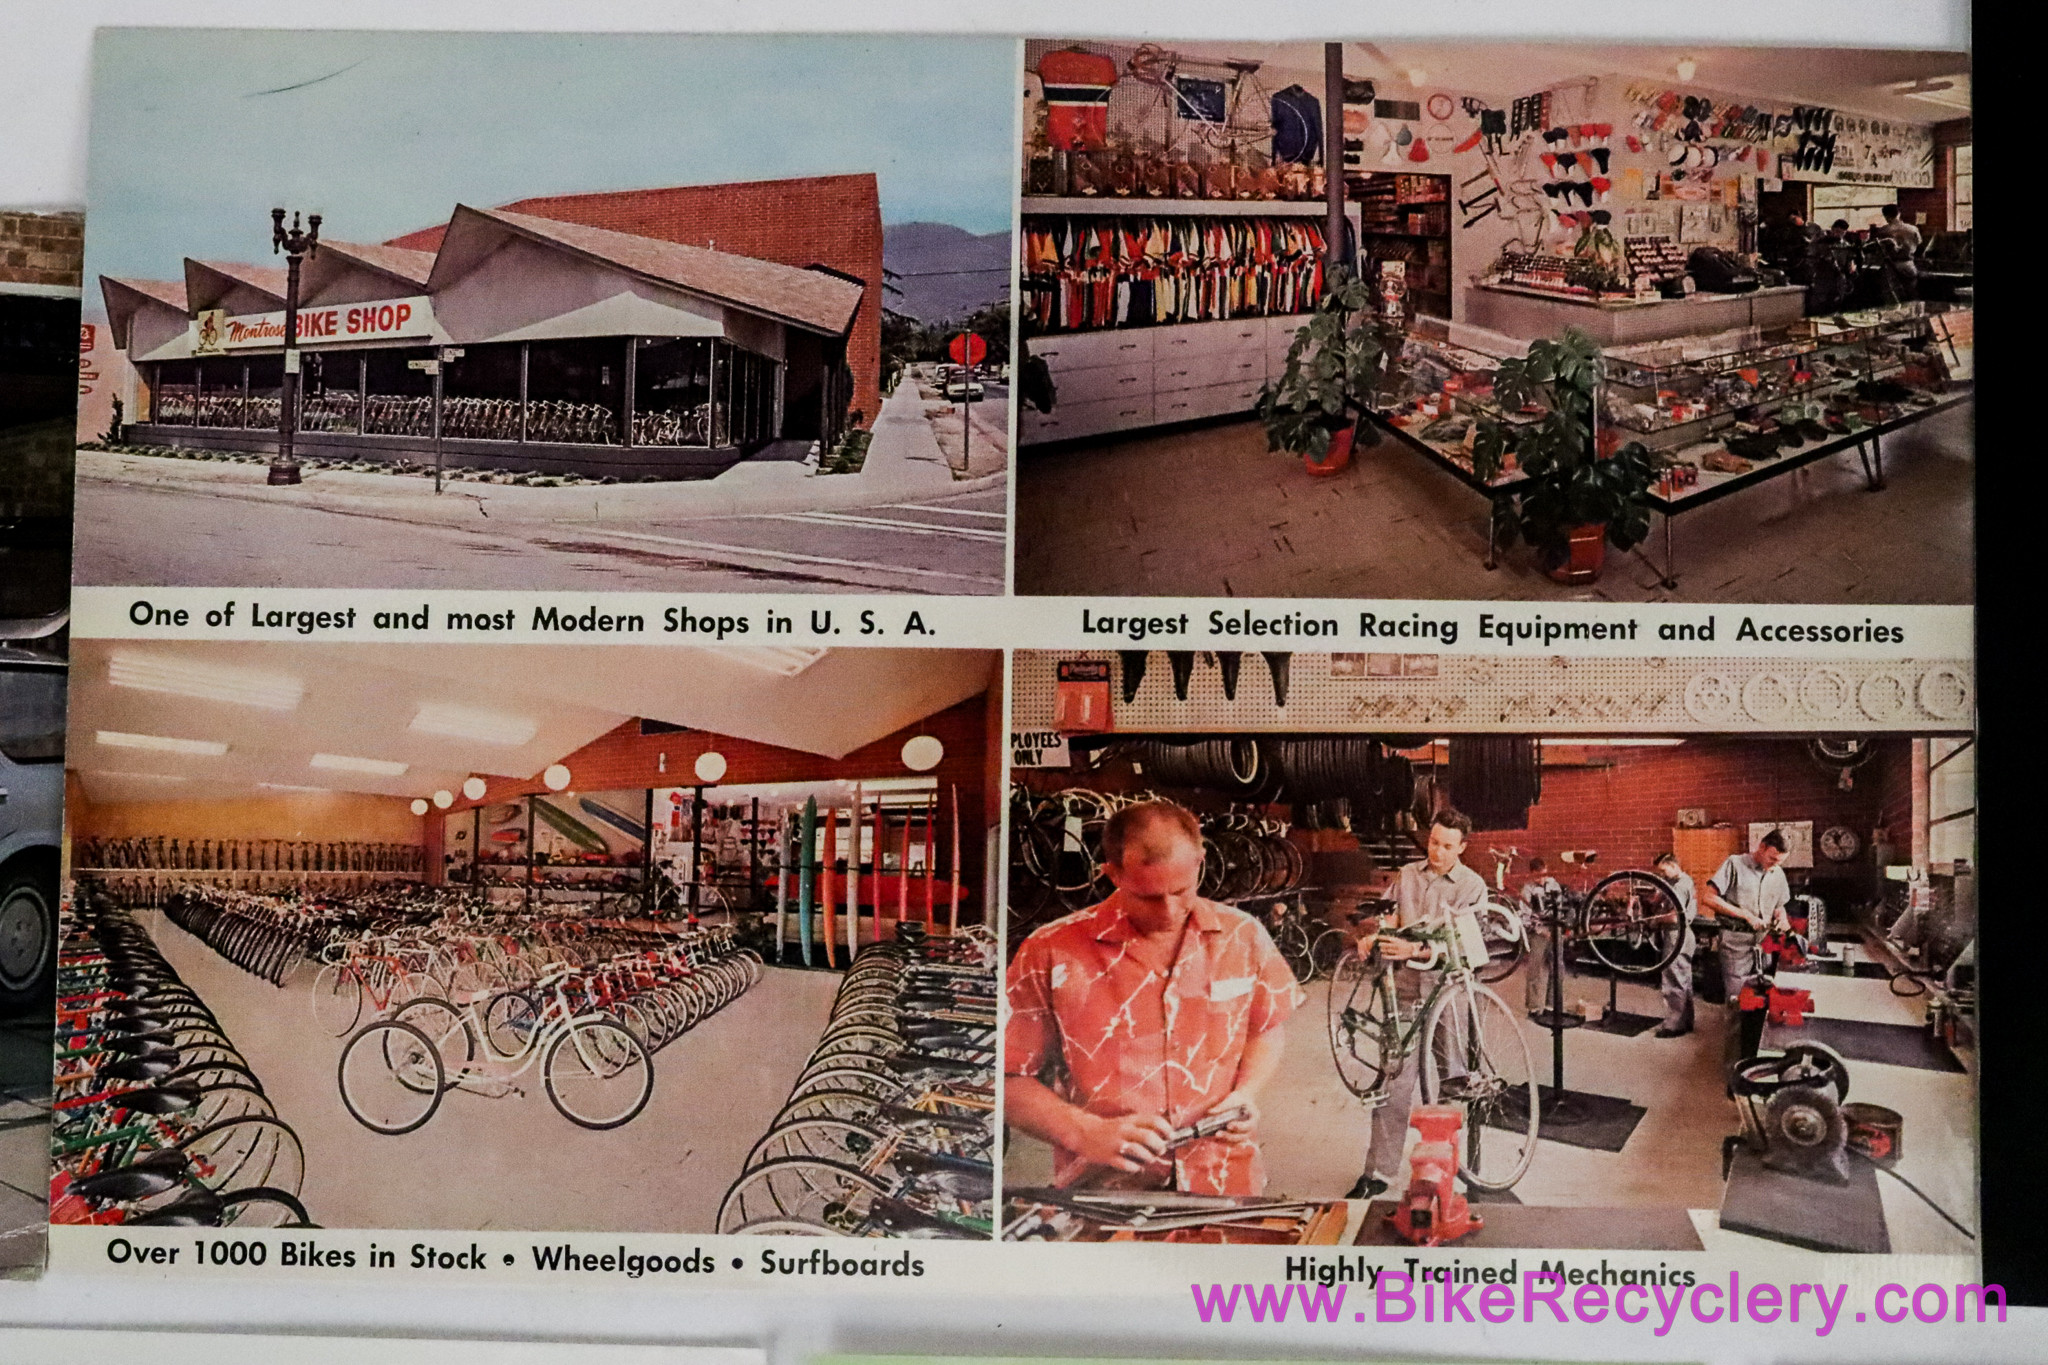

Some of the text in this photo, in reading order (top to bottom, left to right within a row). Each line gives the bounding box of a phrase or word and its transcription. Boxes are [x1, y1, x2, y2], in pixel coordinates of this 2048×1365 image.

[225, 303, 412, 343] Montrose BIKE SHOP
[130, 601, 188, 626] One
[206, 601, 235, 626] of
[253, 602, 356, 634] Largest
[374, 604, 428, 629] and
[448, 609, 515, 630] most
[532, 606, 643, 631] Modern
[664, 607, 748, 638] Shops
[768, 610, 791, 633] in
[1083, 610, 1903, 646] Largest Selection Racing Equipment and Accessories
[1011, 732, 1062, 749] PLOYEES
[1014, 748, 1042, 765] ONLY
[108, 1239, 924, 1278] Over 1000 Bikes in Stock Wheelgoods Surfboards
[1286, 1255, 1696, 1289] Highly Trained Mechanics
